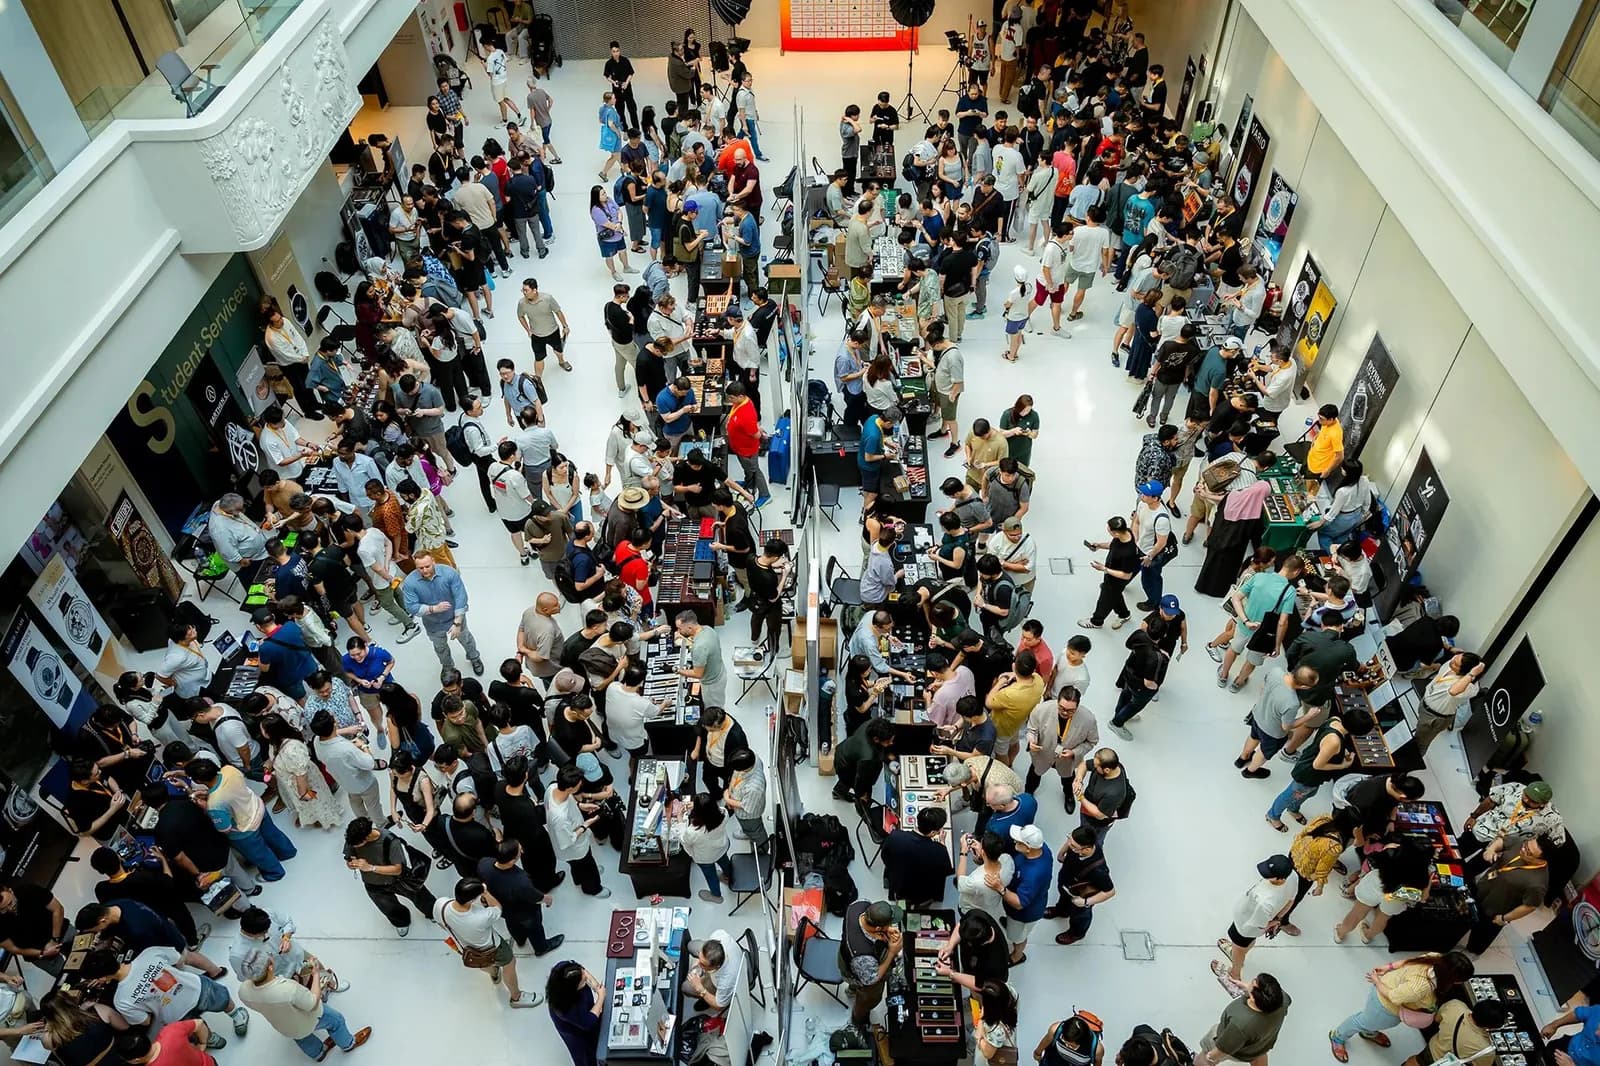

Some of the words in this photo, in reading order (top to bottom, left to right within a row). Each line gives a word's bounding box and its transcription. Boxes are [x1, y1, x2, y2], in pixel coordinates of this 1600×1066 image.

[1251, 122, 1266, 150] VARIO
[128, 341, 206, 455] Student
[200, 281, 249, 348] Services
[130, 982, 143, 999] HOW
[140, 964, 156, 983] LONG
[148, 961, 165, 983] GONE?
